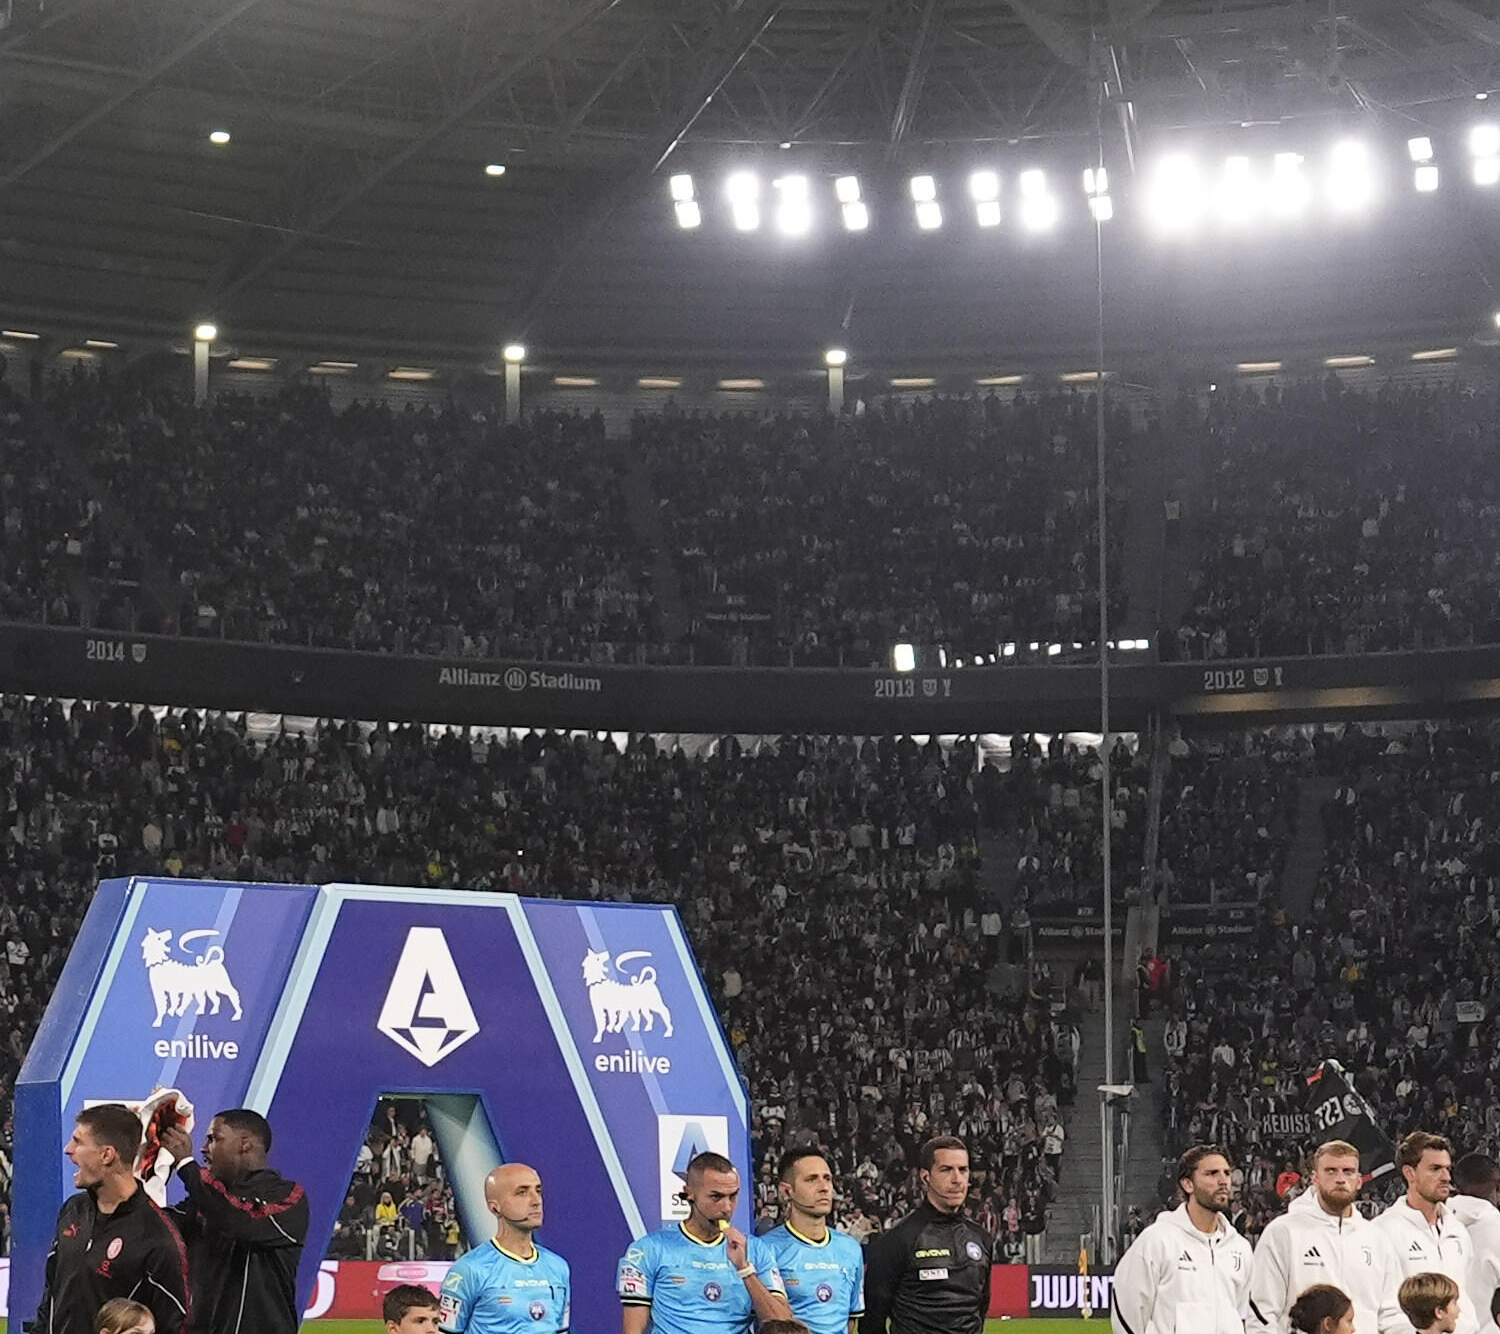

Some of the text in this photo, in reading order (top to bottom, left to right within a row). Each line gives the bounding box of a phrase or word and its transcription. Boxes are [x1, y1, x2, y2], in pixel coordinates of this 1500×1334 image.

[86, 640, 125, 661] 2014
[438, 666, 602, 691] Allianz Stadium
[874, 678, 914, 697] 2013
[1204, 669, 1245, 691] 2012
[154, 1034, 239, 1060] enilive
[595, 1050, 671, 1075] enilive
[915, 1248, 951, 1259] GIVOVA
